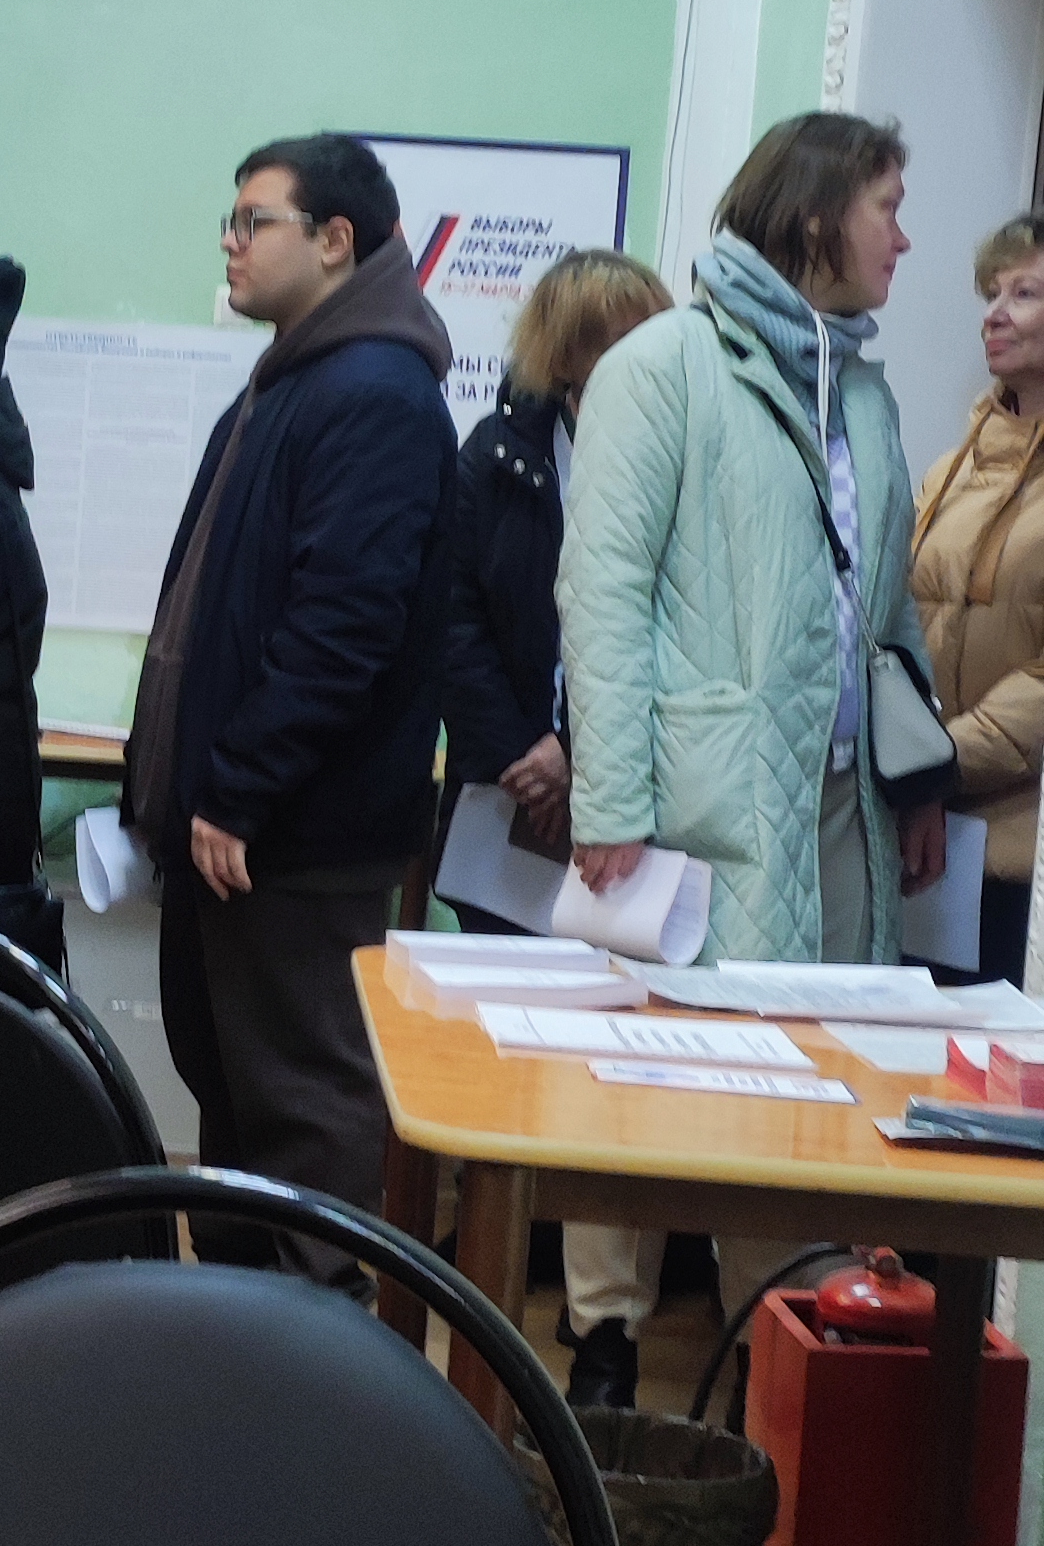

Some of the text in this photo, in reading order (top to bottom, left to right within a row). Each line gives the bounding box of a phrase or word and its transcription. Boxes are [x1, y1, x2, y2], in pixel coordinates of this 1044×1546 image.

[470, 214, 553, 236] ВЫБОРЫ
[448, 257, 523, 279] РОССИИ
[455, 379, 478, 402] ЗА
